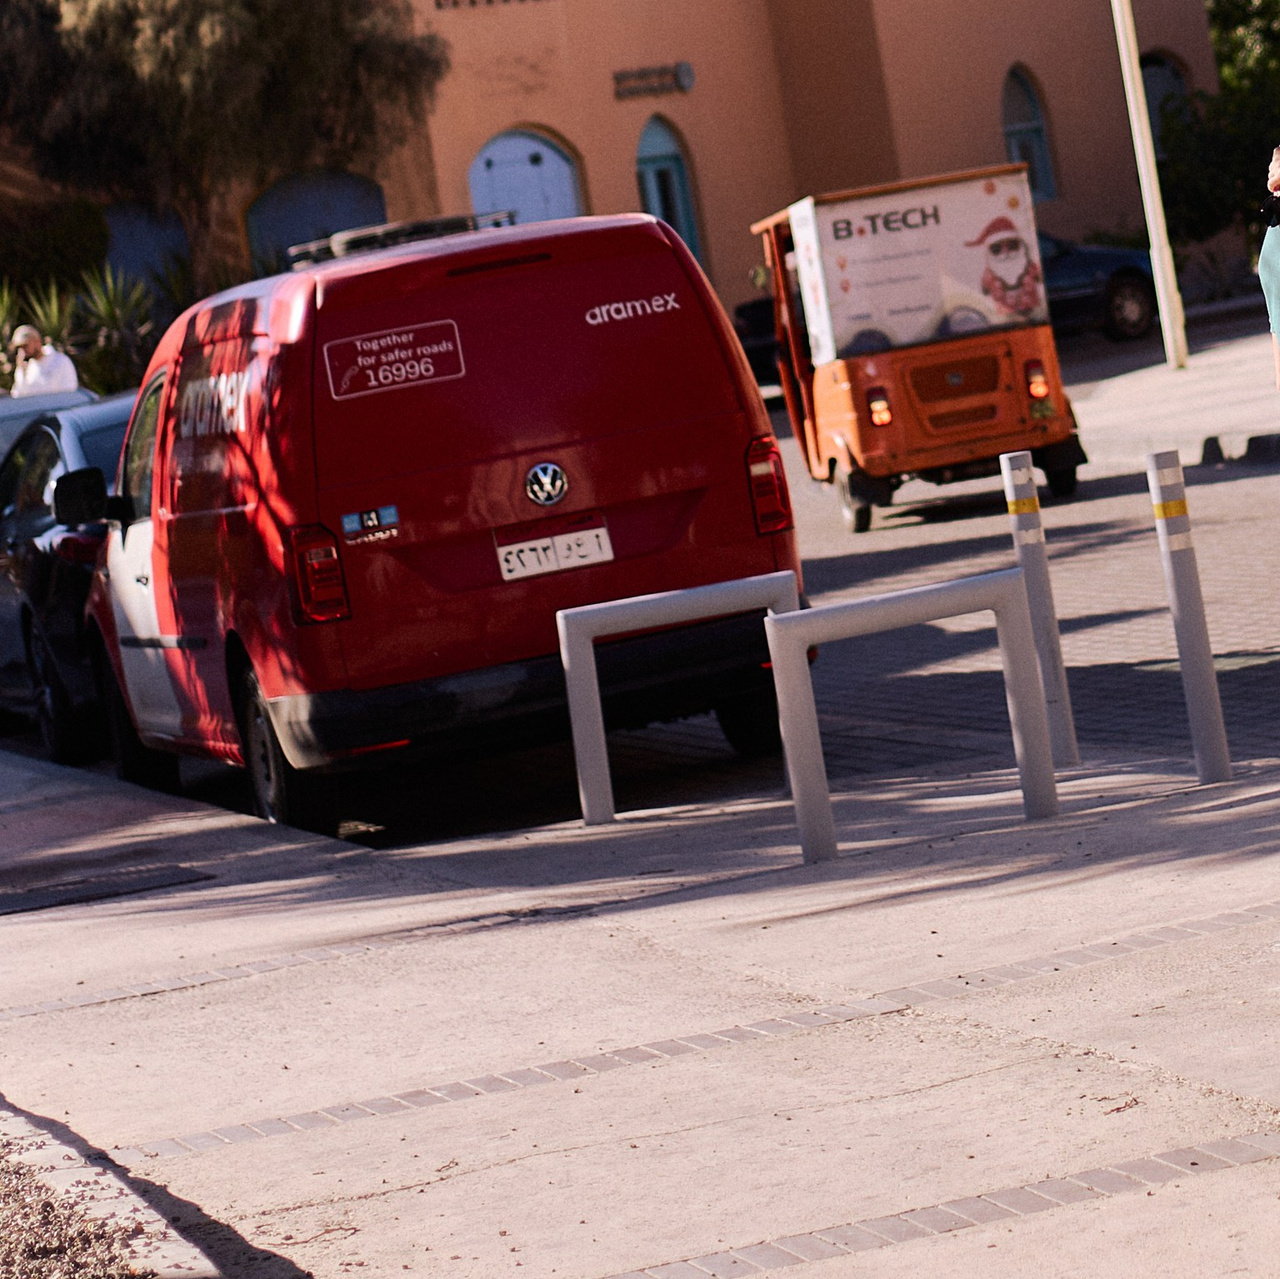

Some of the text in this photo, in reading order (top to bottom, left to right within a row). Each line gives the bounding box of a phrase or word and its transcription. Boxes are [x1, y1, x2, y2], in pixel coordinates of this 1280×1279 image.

[585, 292, 681, 325] aramex
[354, 332, 415, 351] Together
[357, 339, 454, 368] for safer roads
[365, 357, 436, 387] 16996
